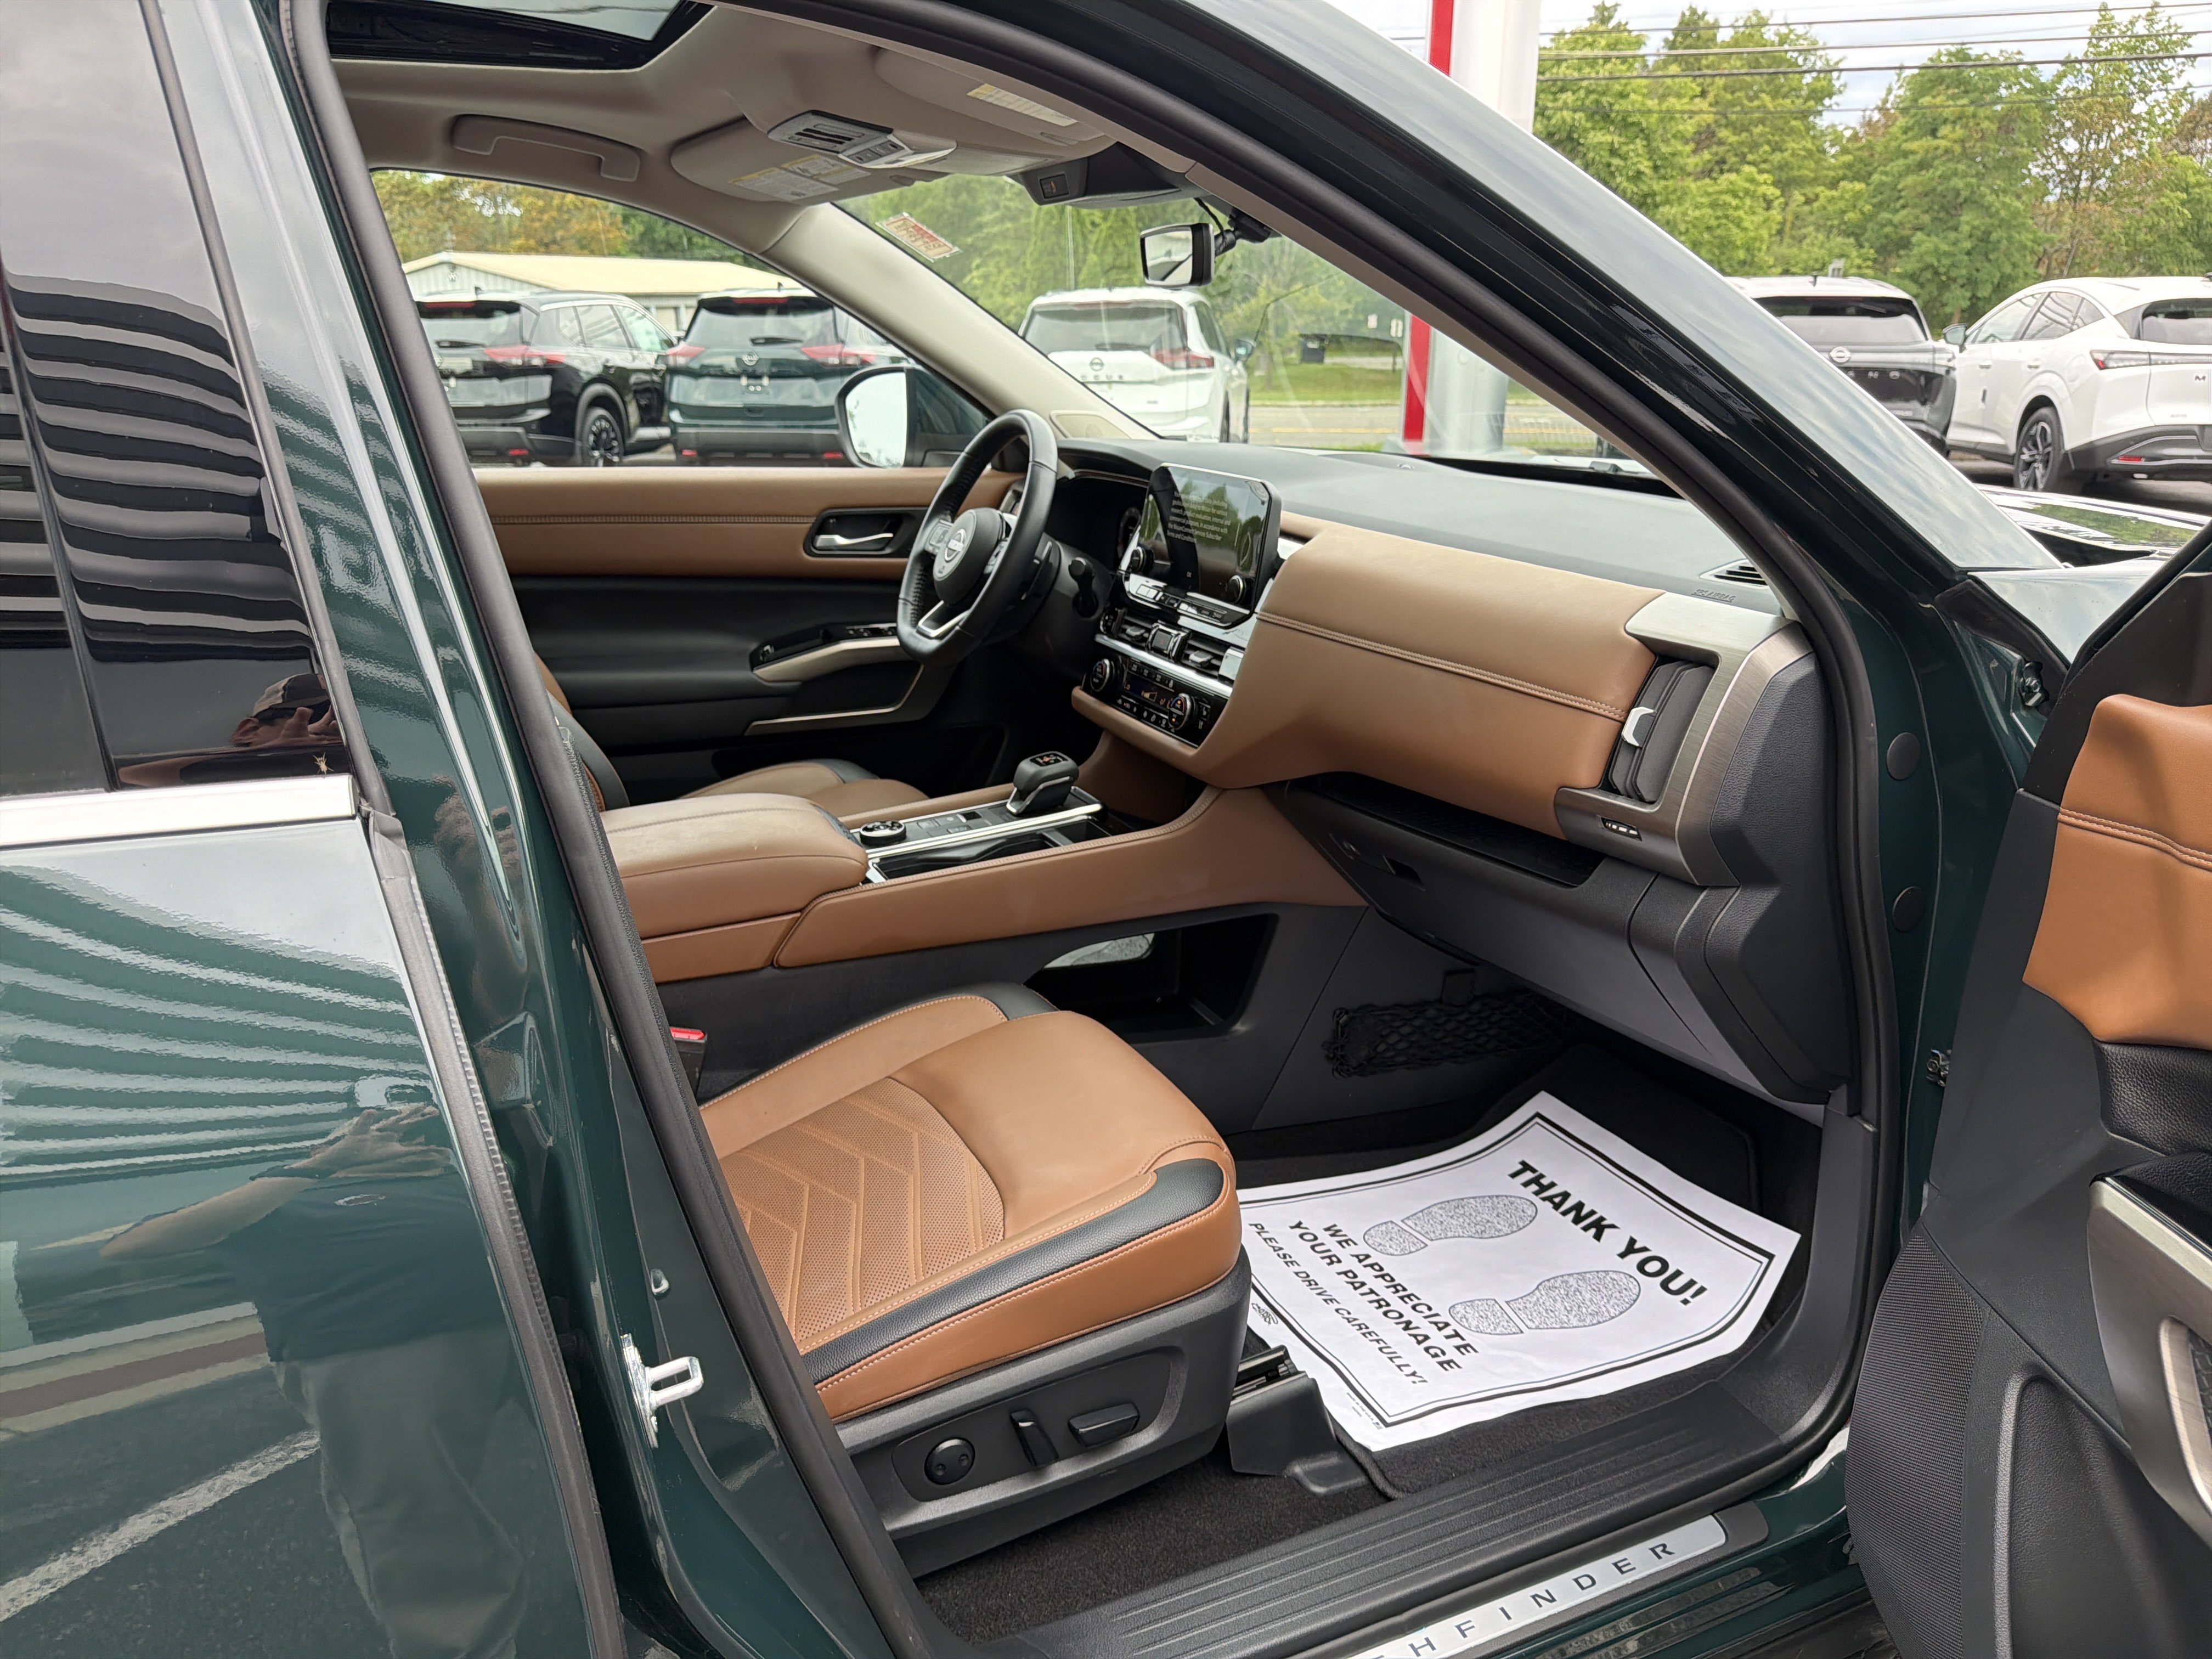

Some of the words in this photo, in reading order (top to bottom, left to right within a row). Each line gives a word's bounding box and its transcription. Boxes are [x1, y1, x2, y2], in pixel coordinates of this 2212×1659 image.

[1249, 1223, 1301, 1268] PLEASE
[1293, 1271, 1341, 1306] DRIVE
[1334, 1308, 1429, 1385] CAREFULLY!
[1289, 1220, 1343, 1266] YOUR
[1336, 1269, 1463, 1372] PATRONAGE
[1323, 1223, 1358, 1249] WE
[1350, 1253, 1479, 1356] APPRECIATE
[1508, 1159, 1621, 1243] THANK
[1616, 1235, 1708, 1306] YOU!
[1372, 1542, 1676, 1658] HFINDER
